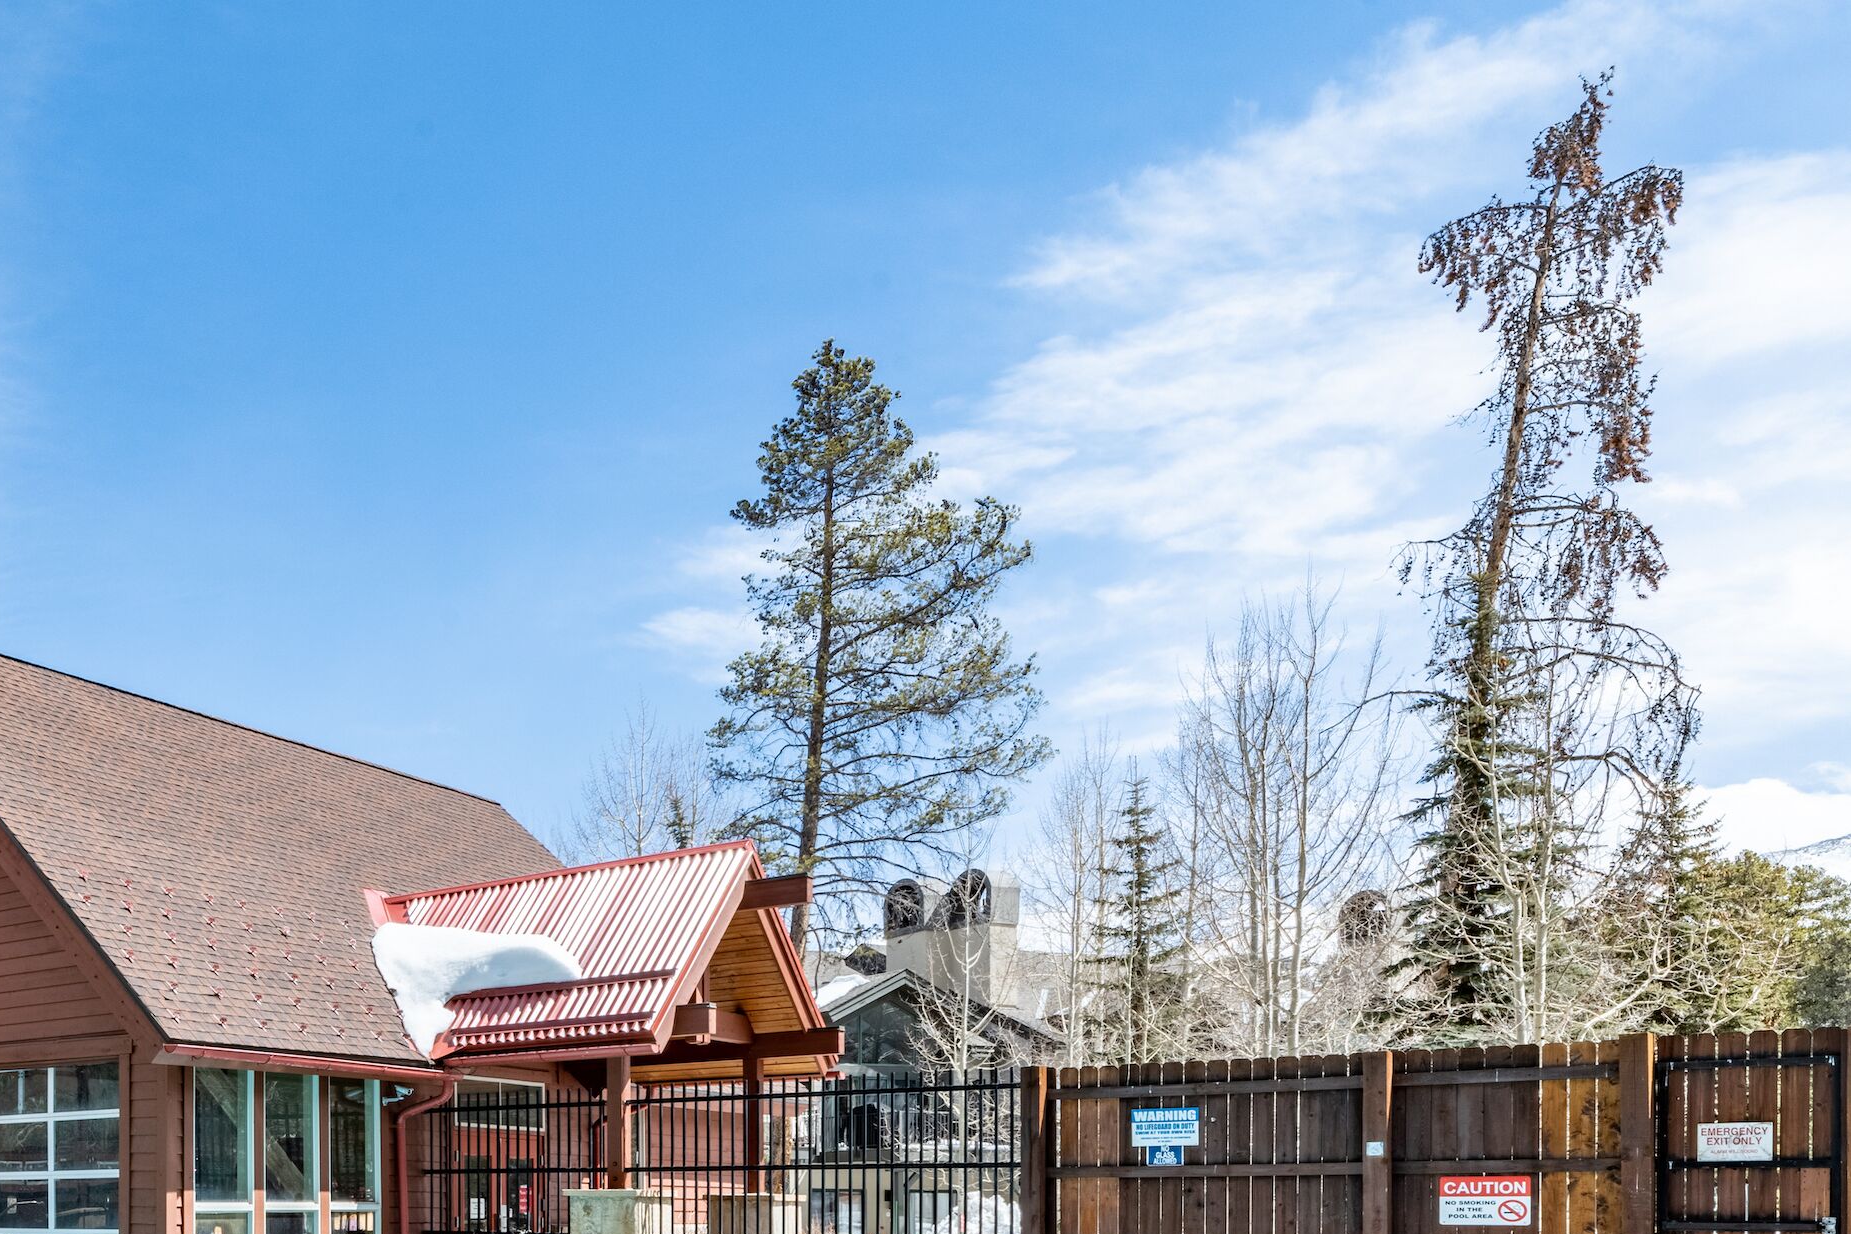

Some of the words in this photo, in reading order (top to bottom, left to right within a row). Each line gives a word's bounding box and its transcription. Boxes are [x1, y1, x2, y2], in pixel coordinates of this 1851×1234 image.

[1133, 1110, 1196, 1121] WARNING
[1144, 1123, 1172, 1131] LIFEGUARD
[1701, 1127, 1768, 1136] EMERGENCY
[1706, 1138, 1730, 1146] EXIT
[1732, 1137, 1762, 1146] ONLY
[1155, 1151, 1175, 1159] GLASS
[1443, 1181, 1527, 1194] CAUTION
